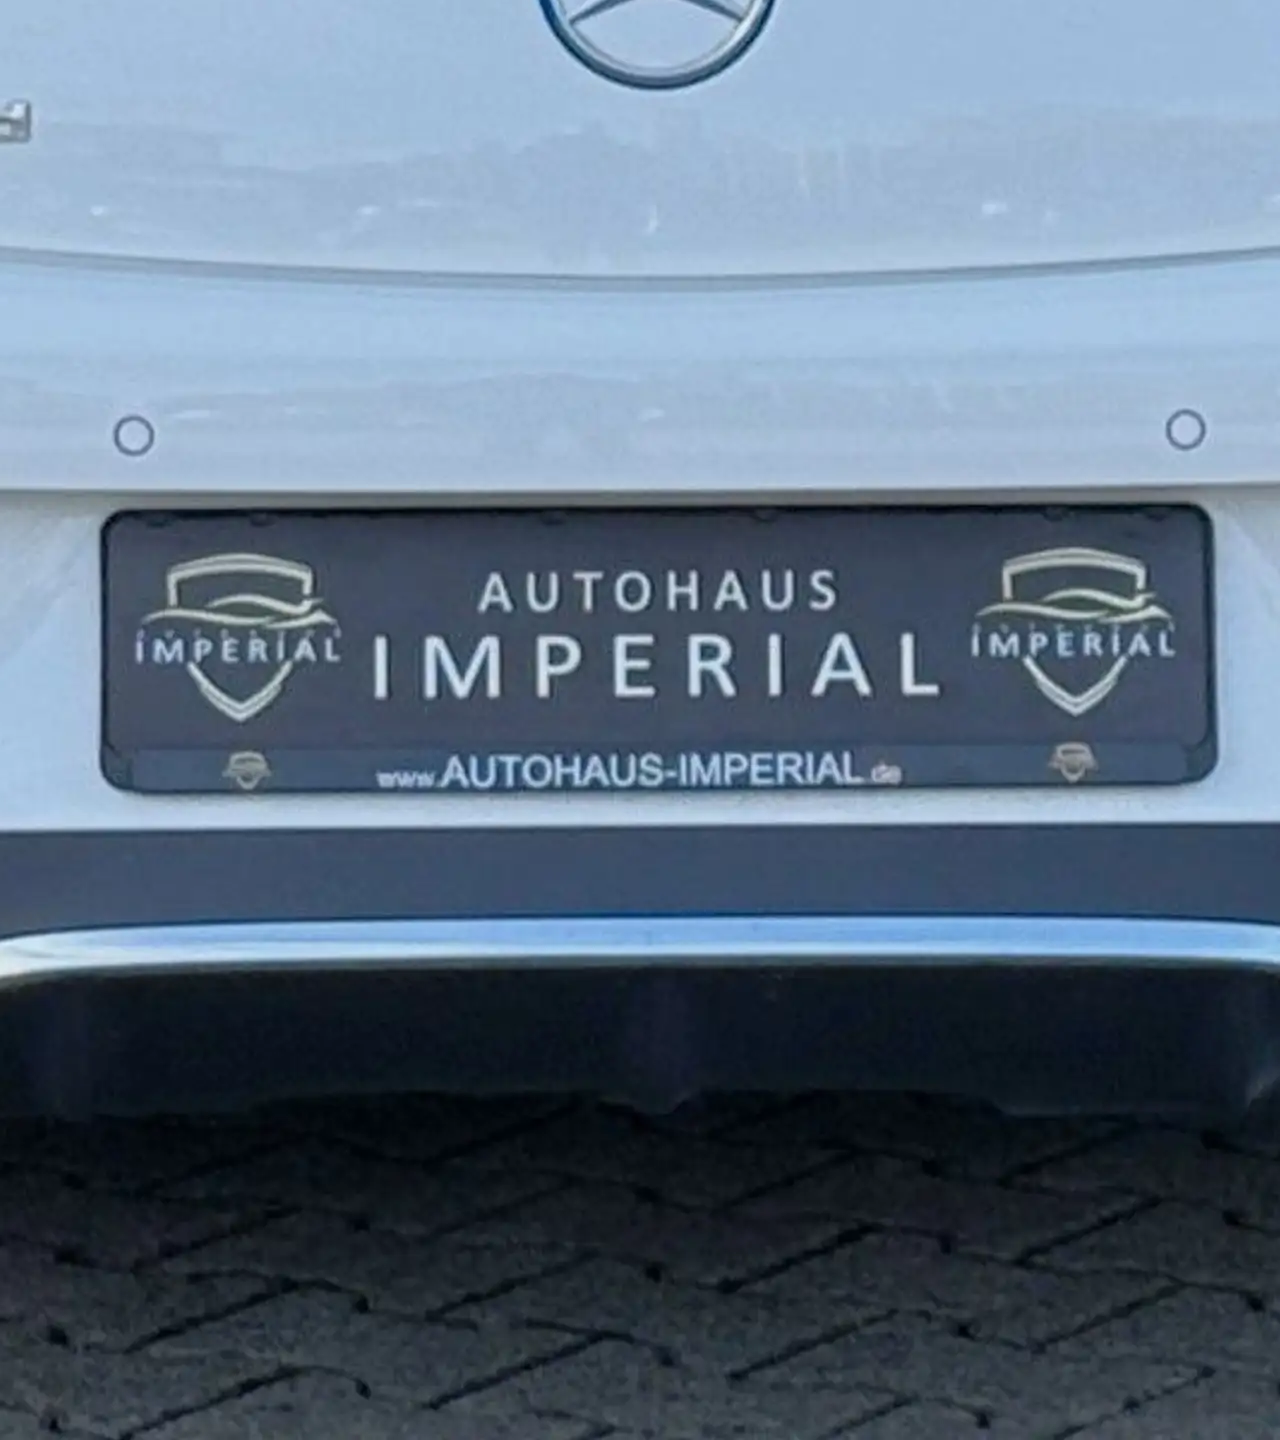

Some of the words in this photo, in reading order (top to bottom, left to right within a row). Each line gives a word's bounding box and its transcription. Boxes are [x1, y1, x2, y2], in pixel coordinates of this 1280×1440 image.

[477, 569, 837, 613] AUTOHAUS
[136, 637, 341, 663] IMPERIAL
[971, 631, 1176, 657] IMPERIAL
[374, 632, 940, 699] IMPERIAL
